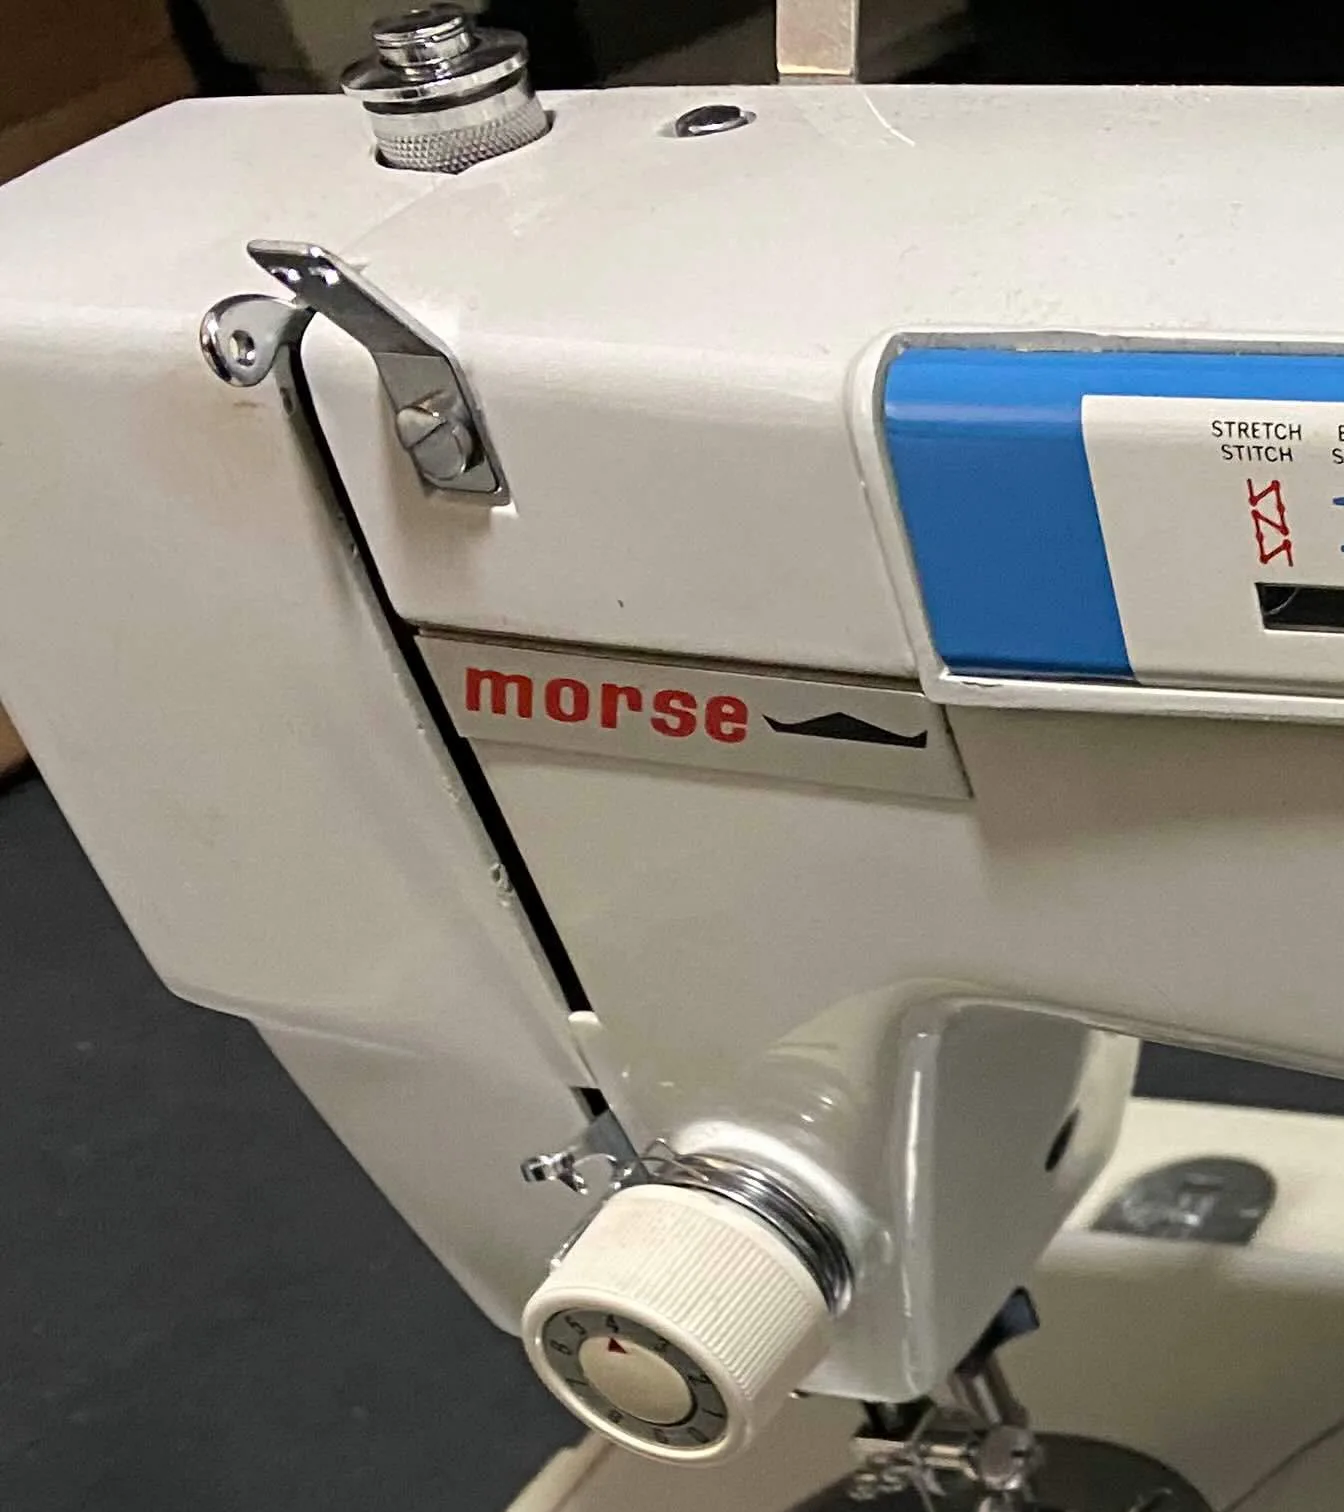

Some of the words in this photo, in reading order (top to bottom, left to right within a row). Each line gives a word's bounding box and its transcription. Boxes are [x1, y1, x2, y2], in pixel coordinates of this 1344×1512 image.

[1211, 420, 1302, 441] STRETCH
[1221, 444, 1293, 463] STITCH
[465, 666, 749, 744] morse
